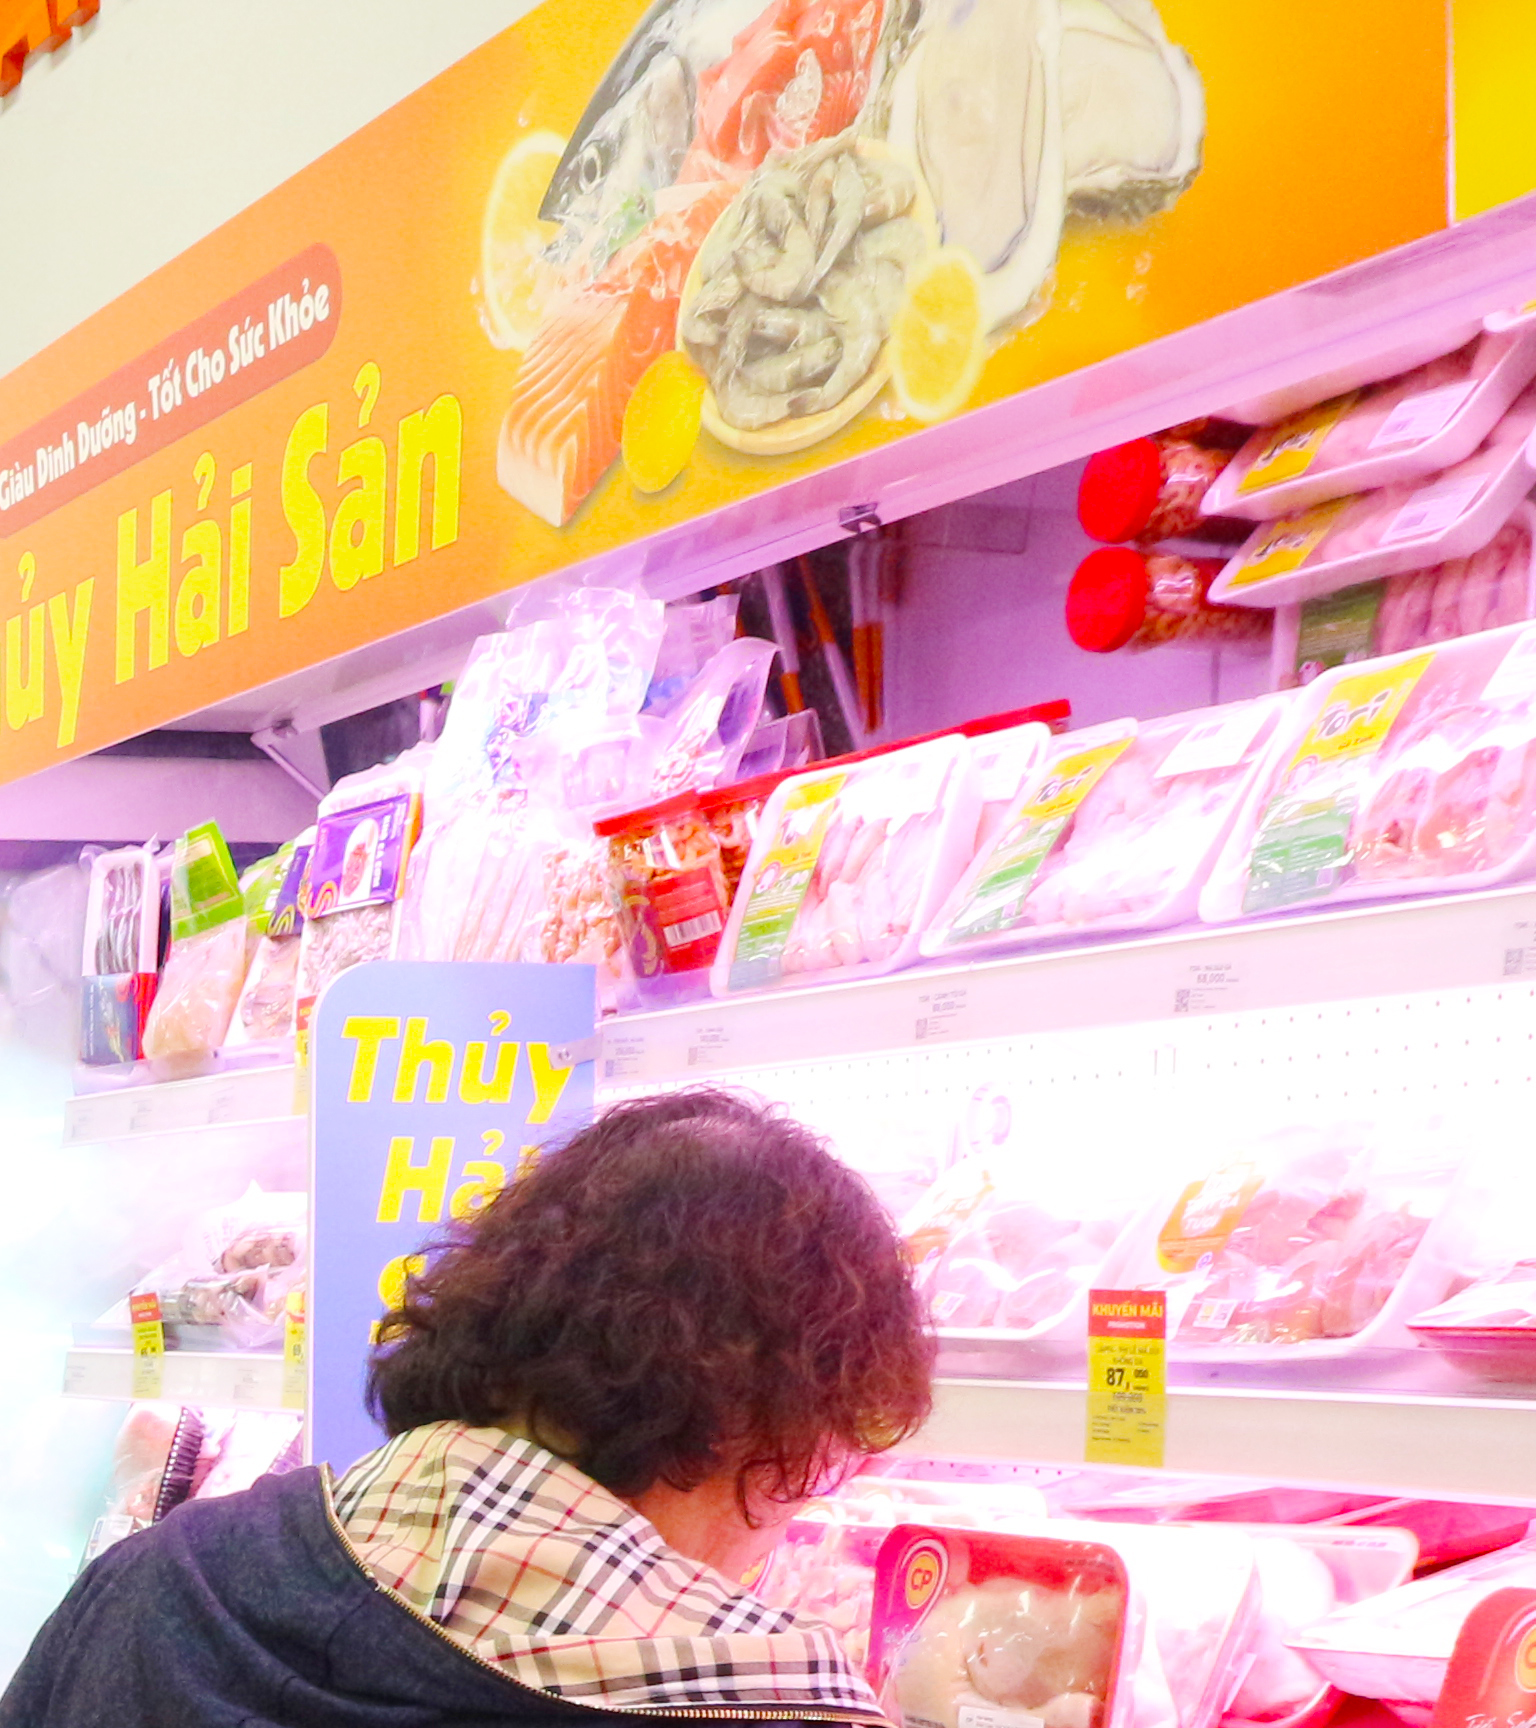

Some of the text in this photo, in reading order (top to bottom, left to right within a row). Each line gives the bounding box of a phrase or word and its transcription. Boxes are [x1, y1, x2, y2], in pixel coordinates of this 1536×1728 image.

[36, 440, 76, 490] Dinh
[77, 400, 137, 462] Dưỡng
[148, 360, 184, 423] Tốt
[185, 347, 226, 399] Cho
[229, 316, 265, 374] Sức
[266, 277, 331, 348] Khỏe
[115, 452, 253, 684] Hải
[278, 361, 462, 620] Sản
[341, 1009, 575, 1125] Thủy
[1092, 1299, 1163, 1318] KHUYẾN MÃI
